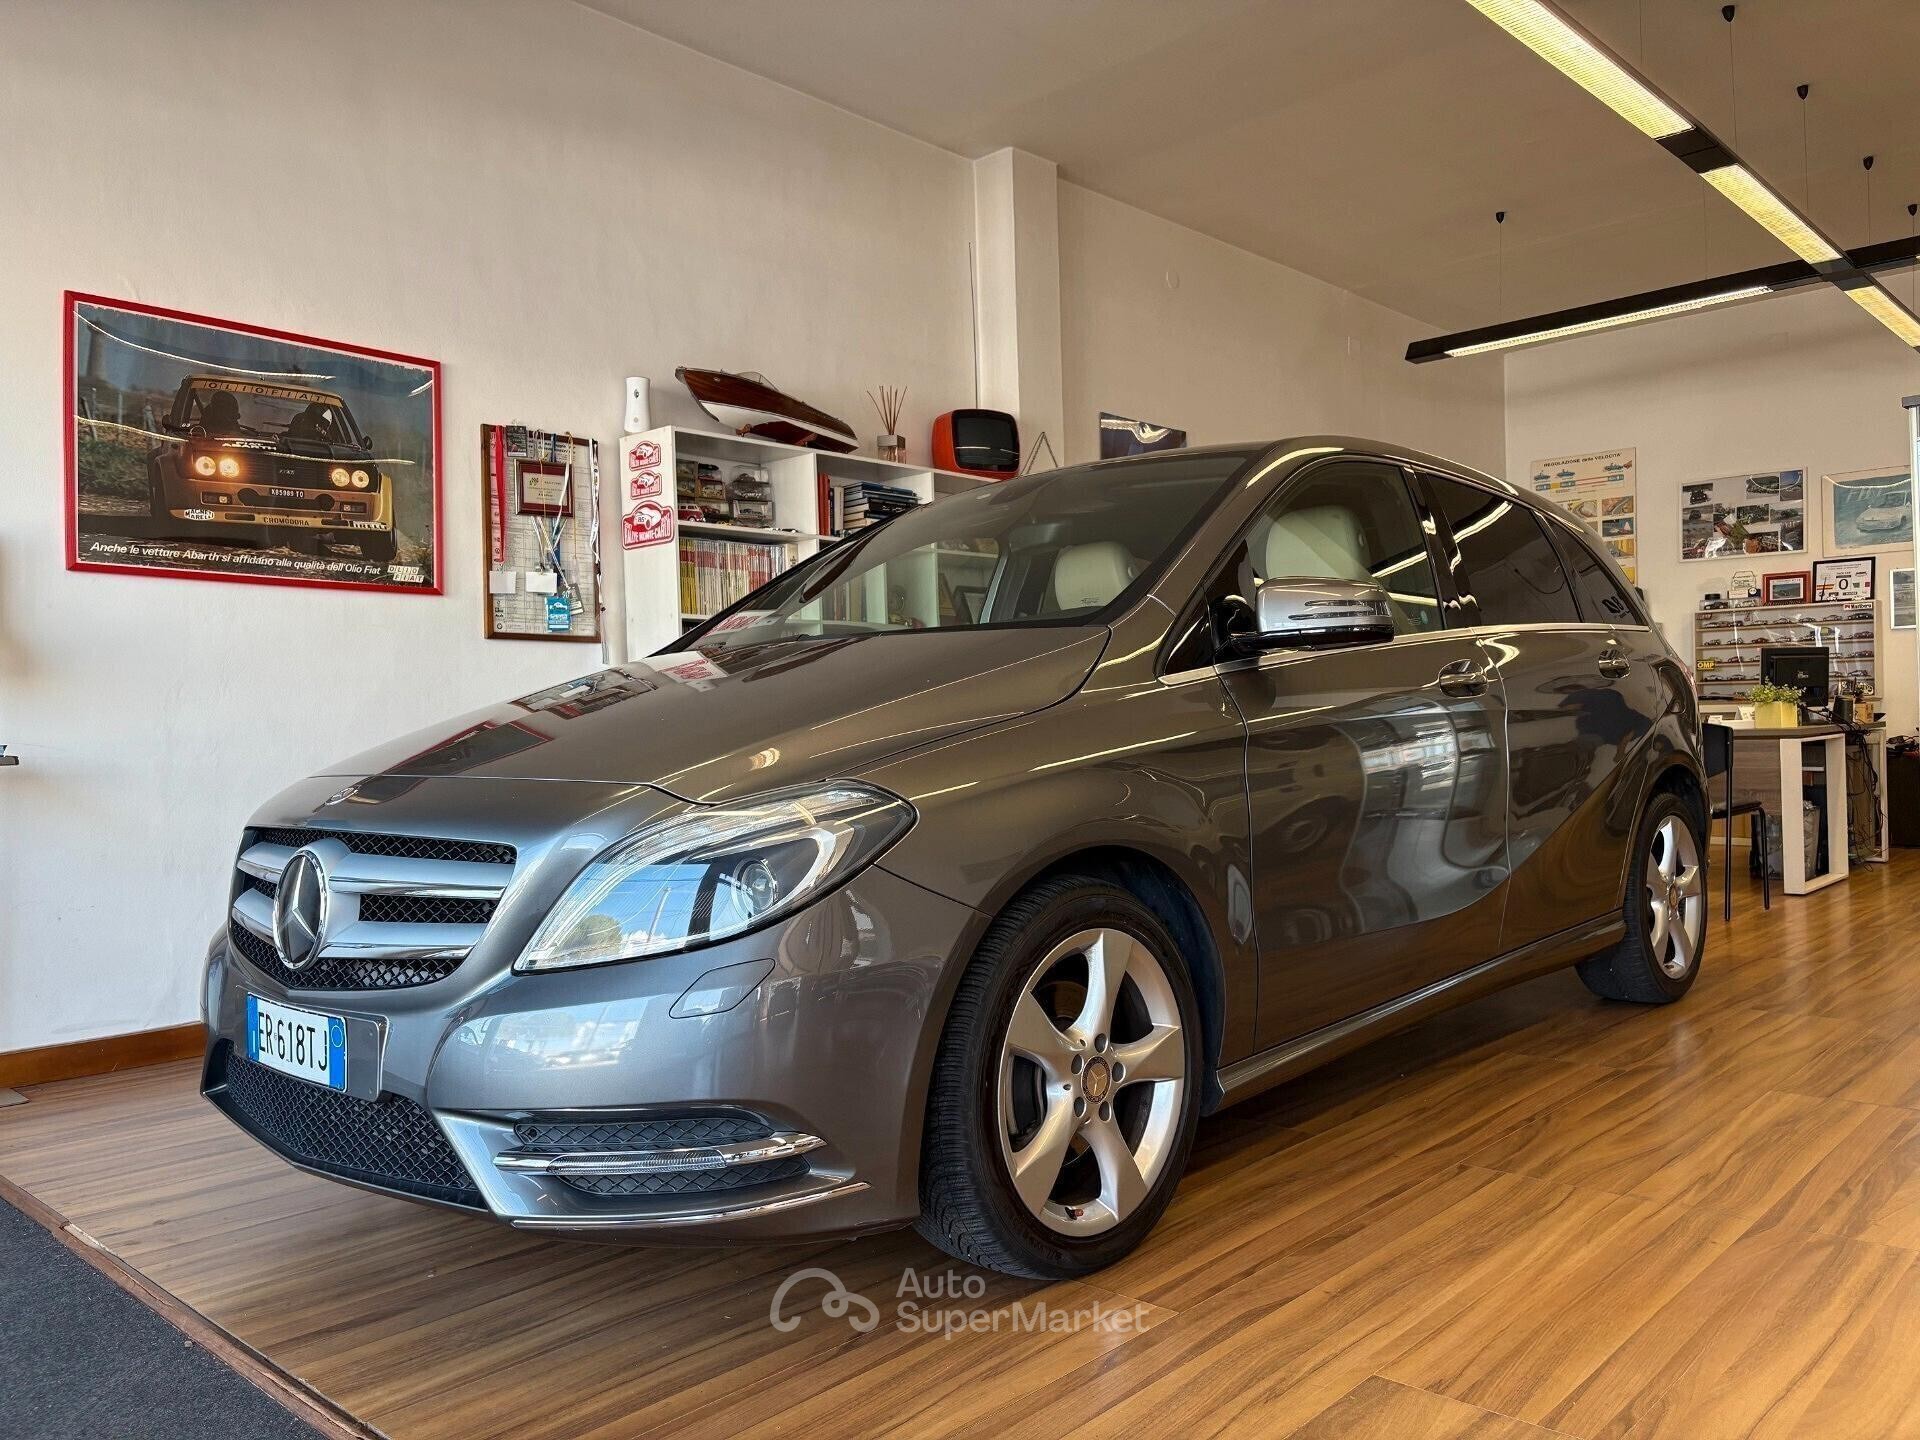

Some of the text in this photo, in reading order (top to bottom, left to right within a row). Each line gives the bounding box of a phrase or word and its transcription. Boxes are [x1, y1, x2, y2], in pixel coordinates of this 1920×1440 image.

[89, 541, 128, 555] Anche
[129, 544, 140, 555] le
[142, 547, 181, 558] vetture
[182, 549, 220, 562] Abarth
[221, 552, 231, 562] si
[232, 553, 274, 566] affidano
[275, 558, 292, 567] alla
[293, 560, 325, 571] qualità
[363, 565, 382, 575] Fiat
[388, 565, 419, 574] OLIO
[393, 573, 424, 583] FIAT
[1696, 661, 1715, 669] OMP
